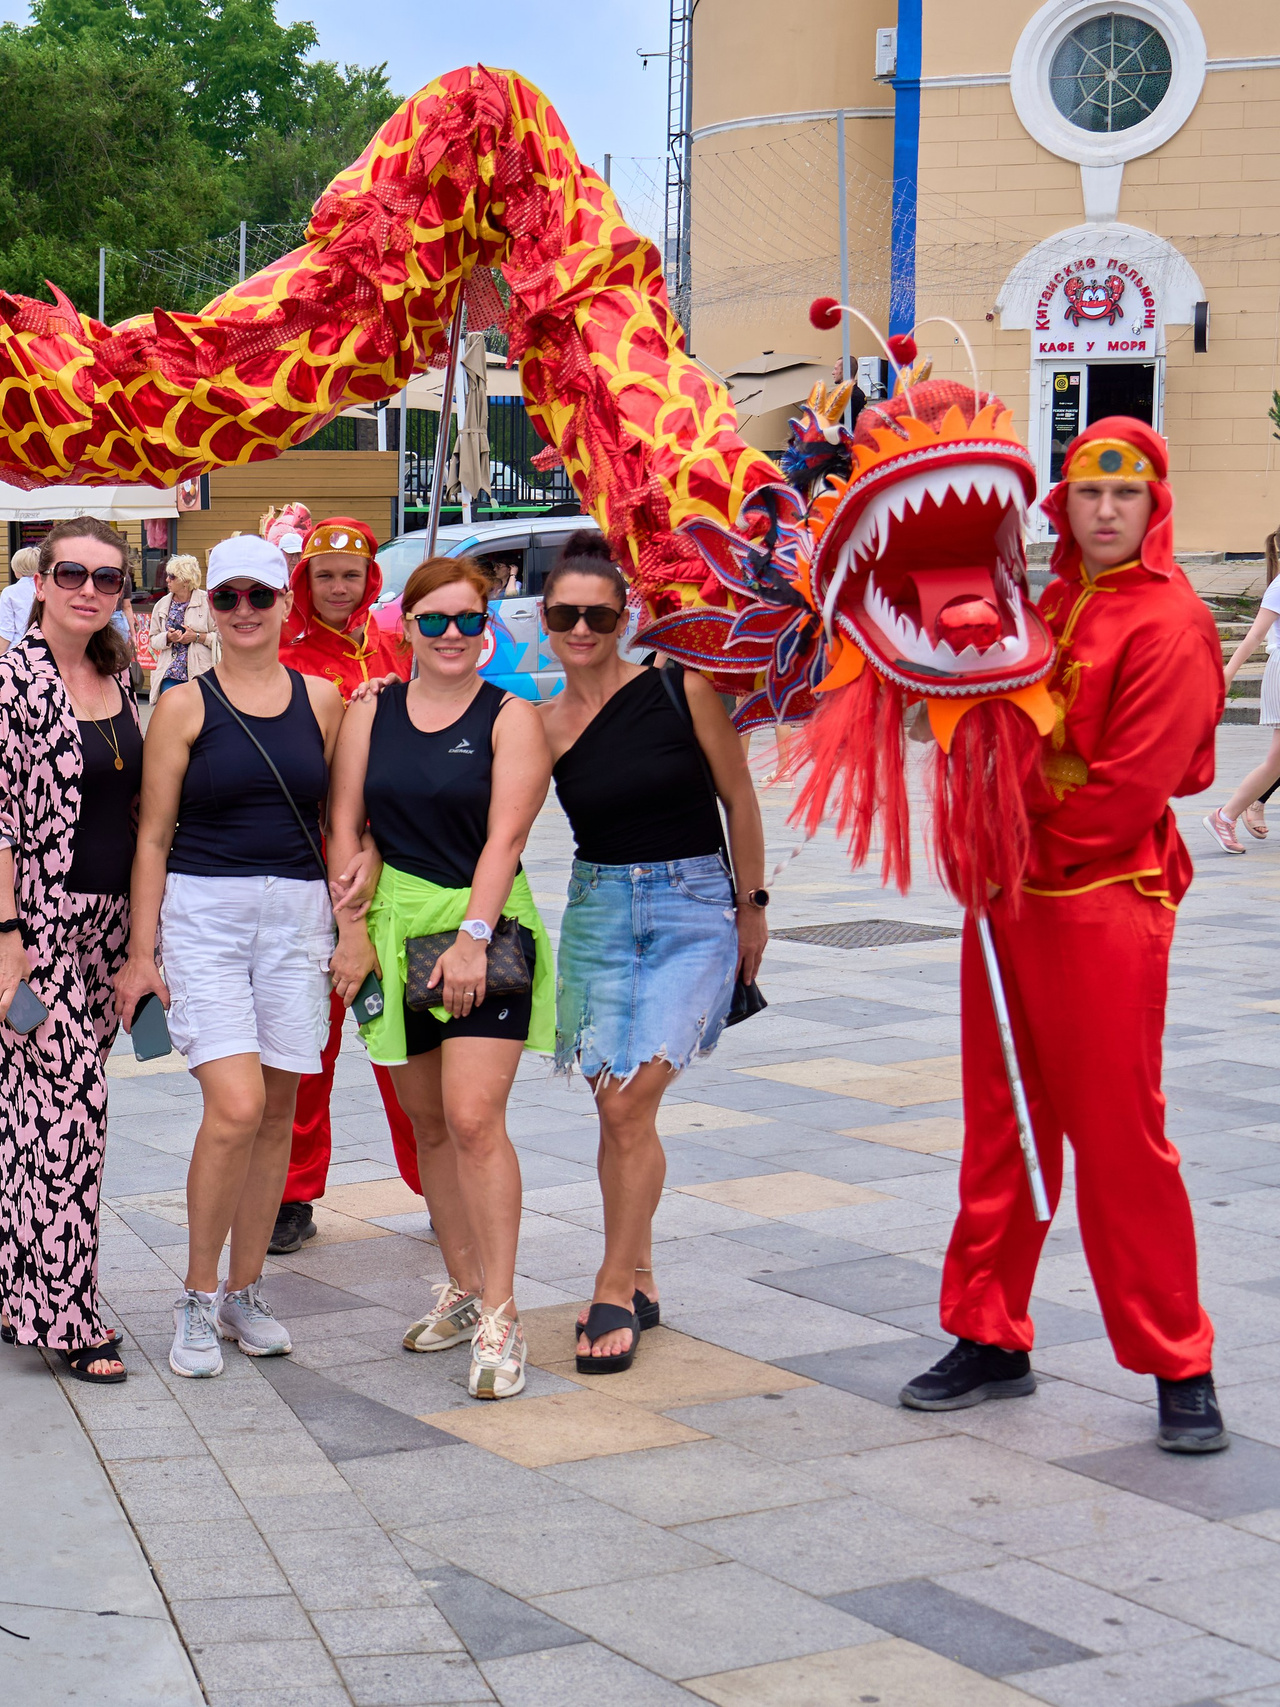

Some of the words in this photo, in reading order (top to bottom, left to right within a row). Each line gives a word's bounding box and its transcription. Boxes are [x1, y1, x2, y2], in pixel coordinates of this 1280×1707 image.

[1039, 342, 1075, 353] КАФЕ
[1086, 341, 1095, 352] У
[1107, 340, 1147, 351] МОРЯ
